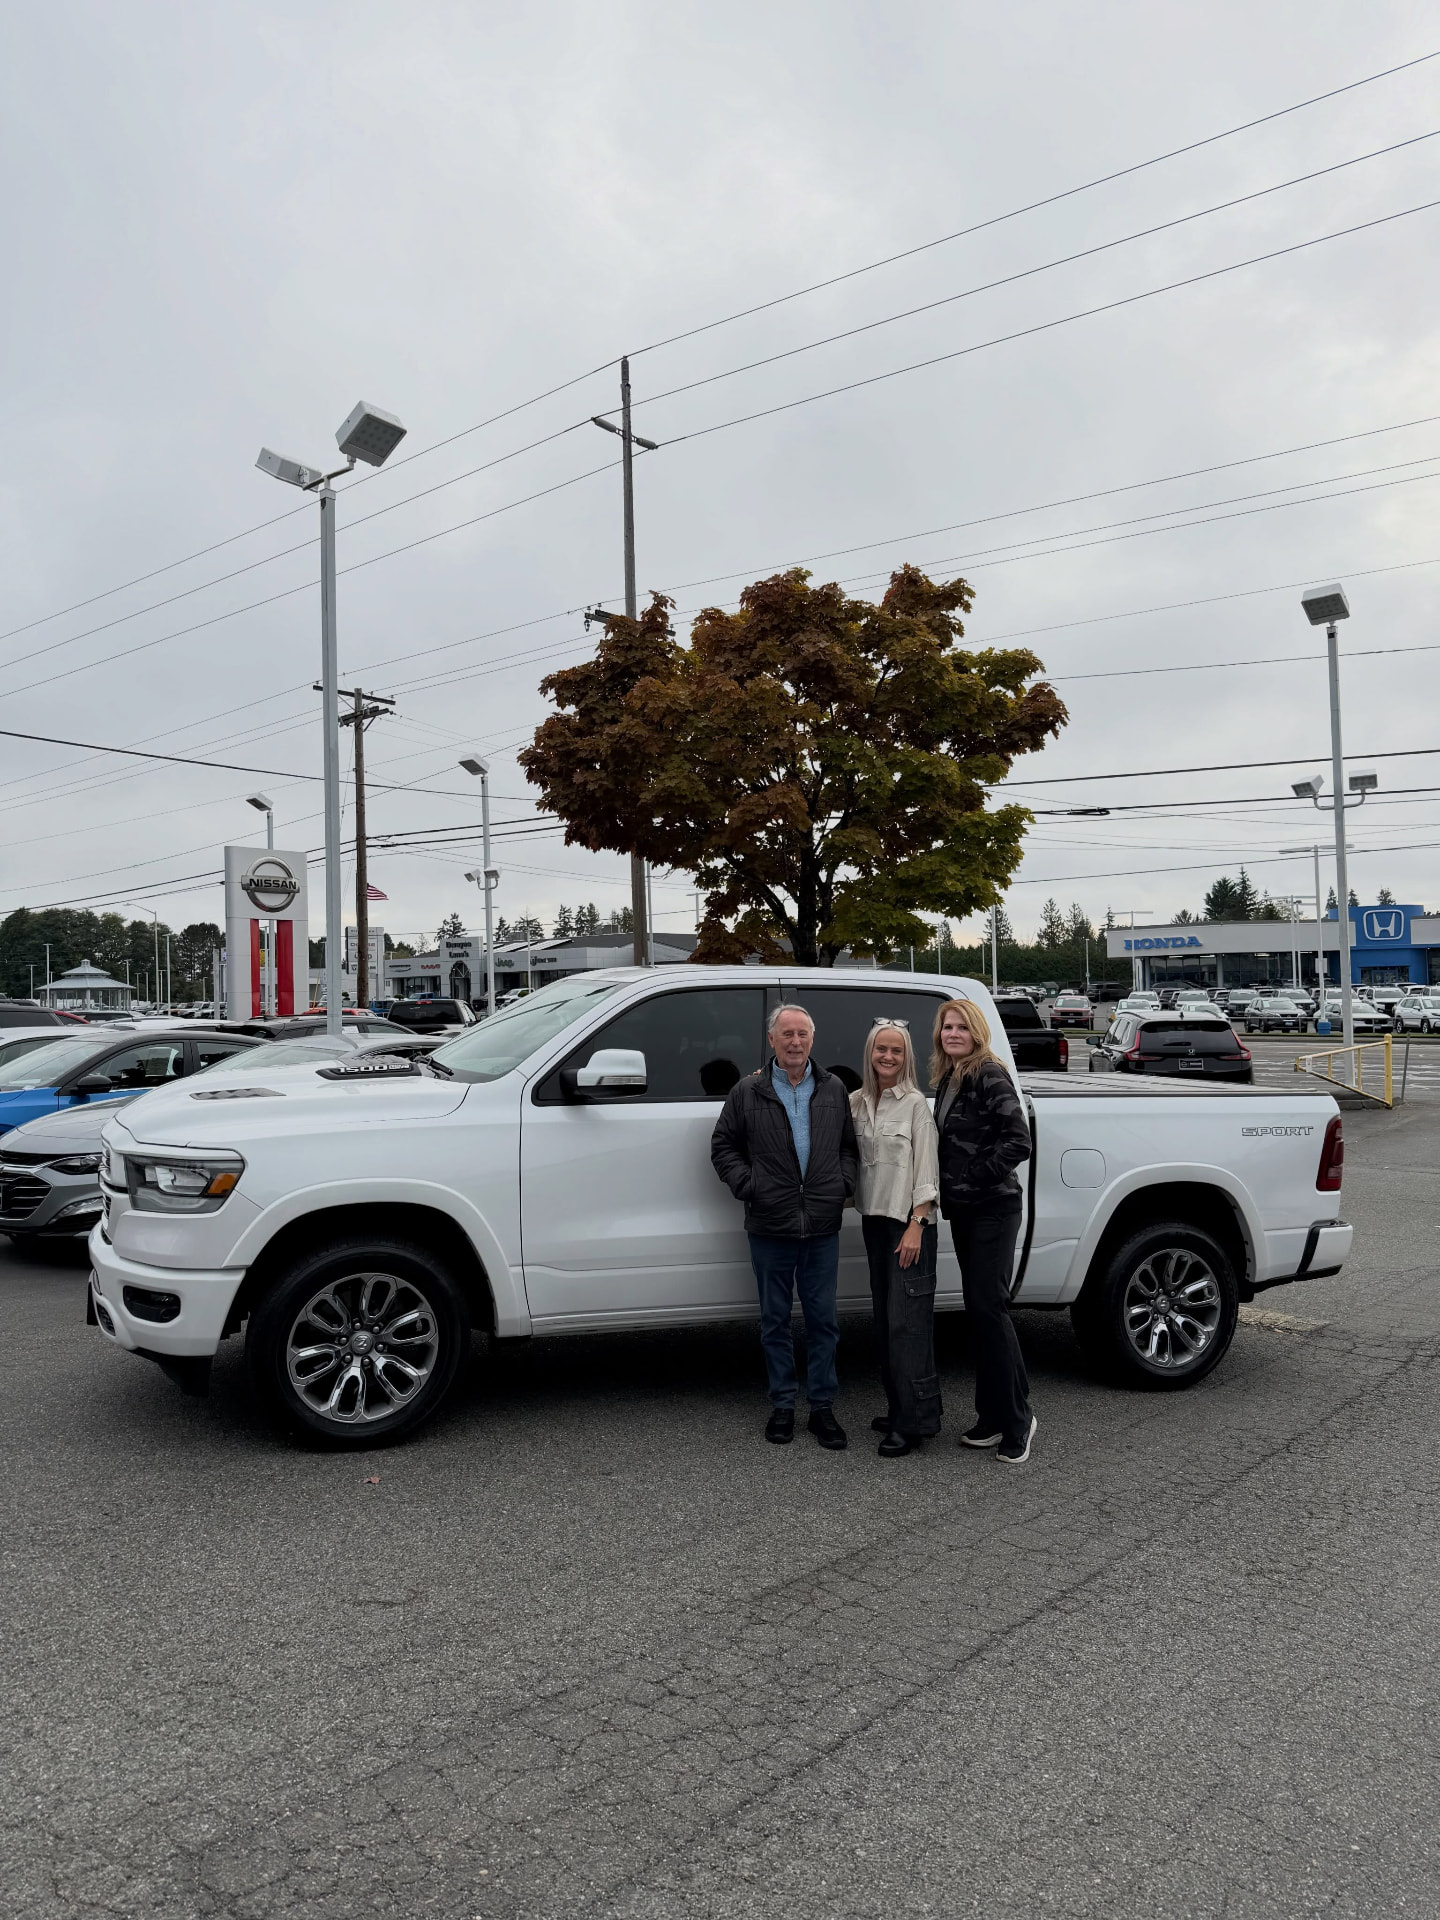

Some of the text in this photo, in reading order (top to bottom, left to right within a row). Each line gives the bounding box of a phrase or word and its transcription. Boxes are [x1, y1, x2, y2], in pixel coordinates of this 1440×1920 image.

[249, 878, 297, 890] NISSAN
[1124, 936, 1203, 950] HONDA
[340, 1065, 388, 1073] 1500
[1241, 1126, 1314, 1137] SPORT
